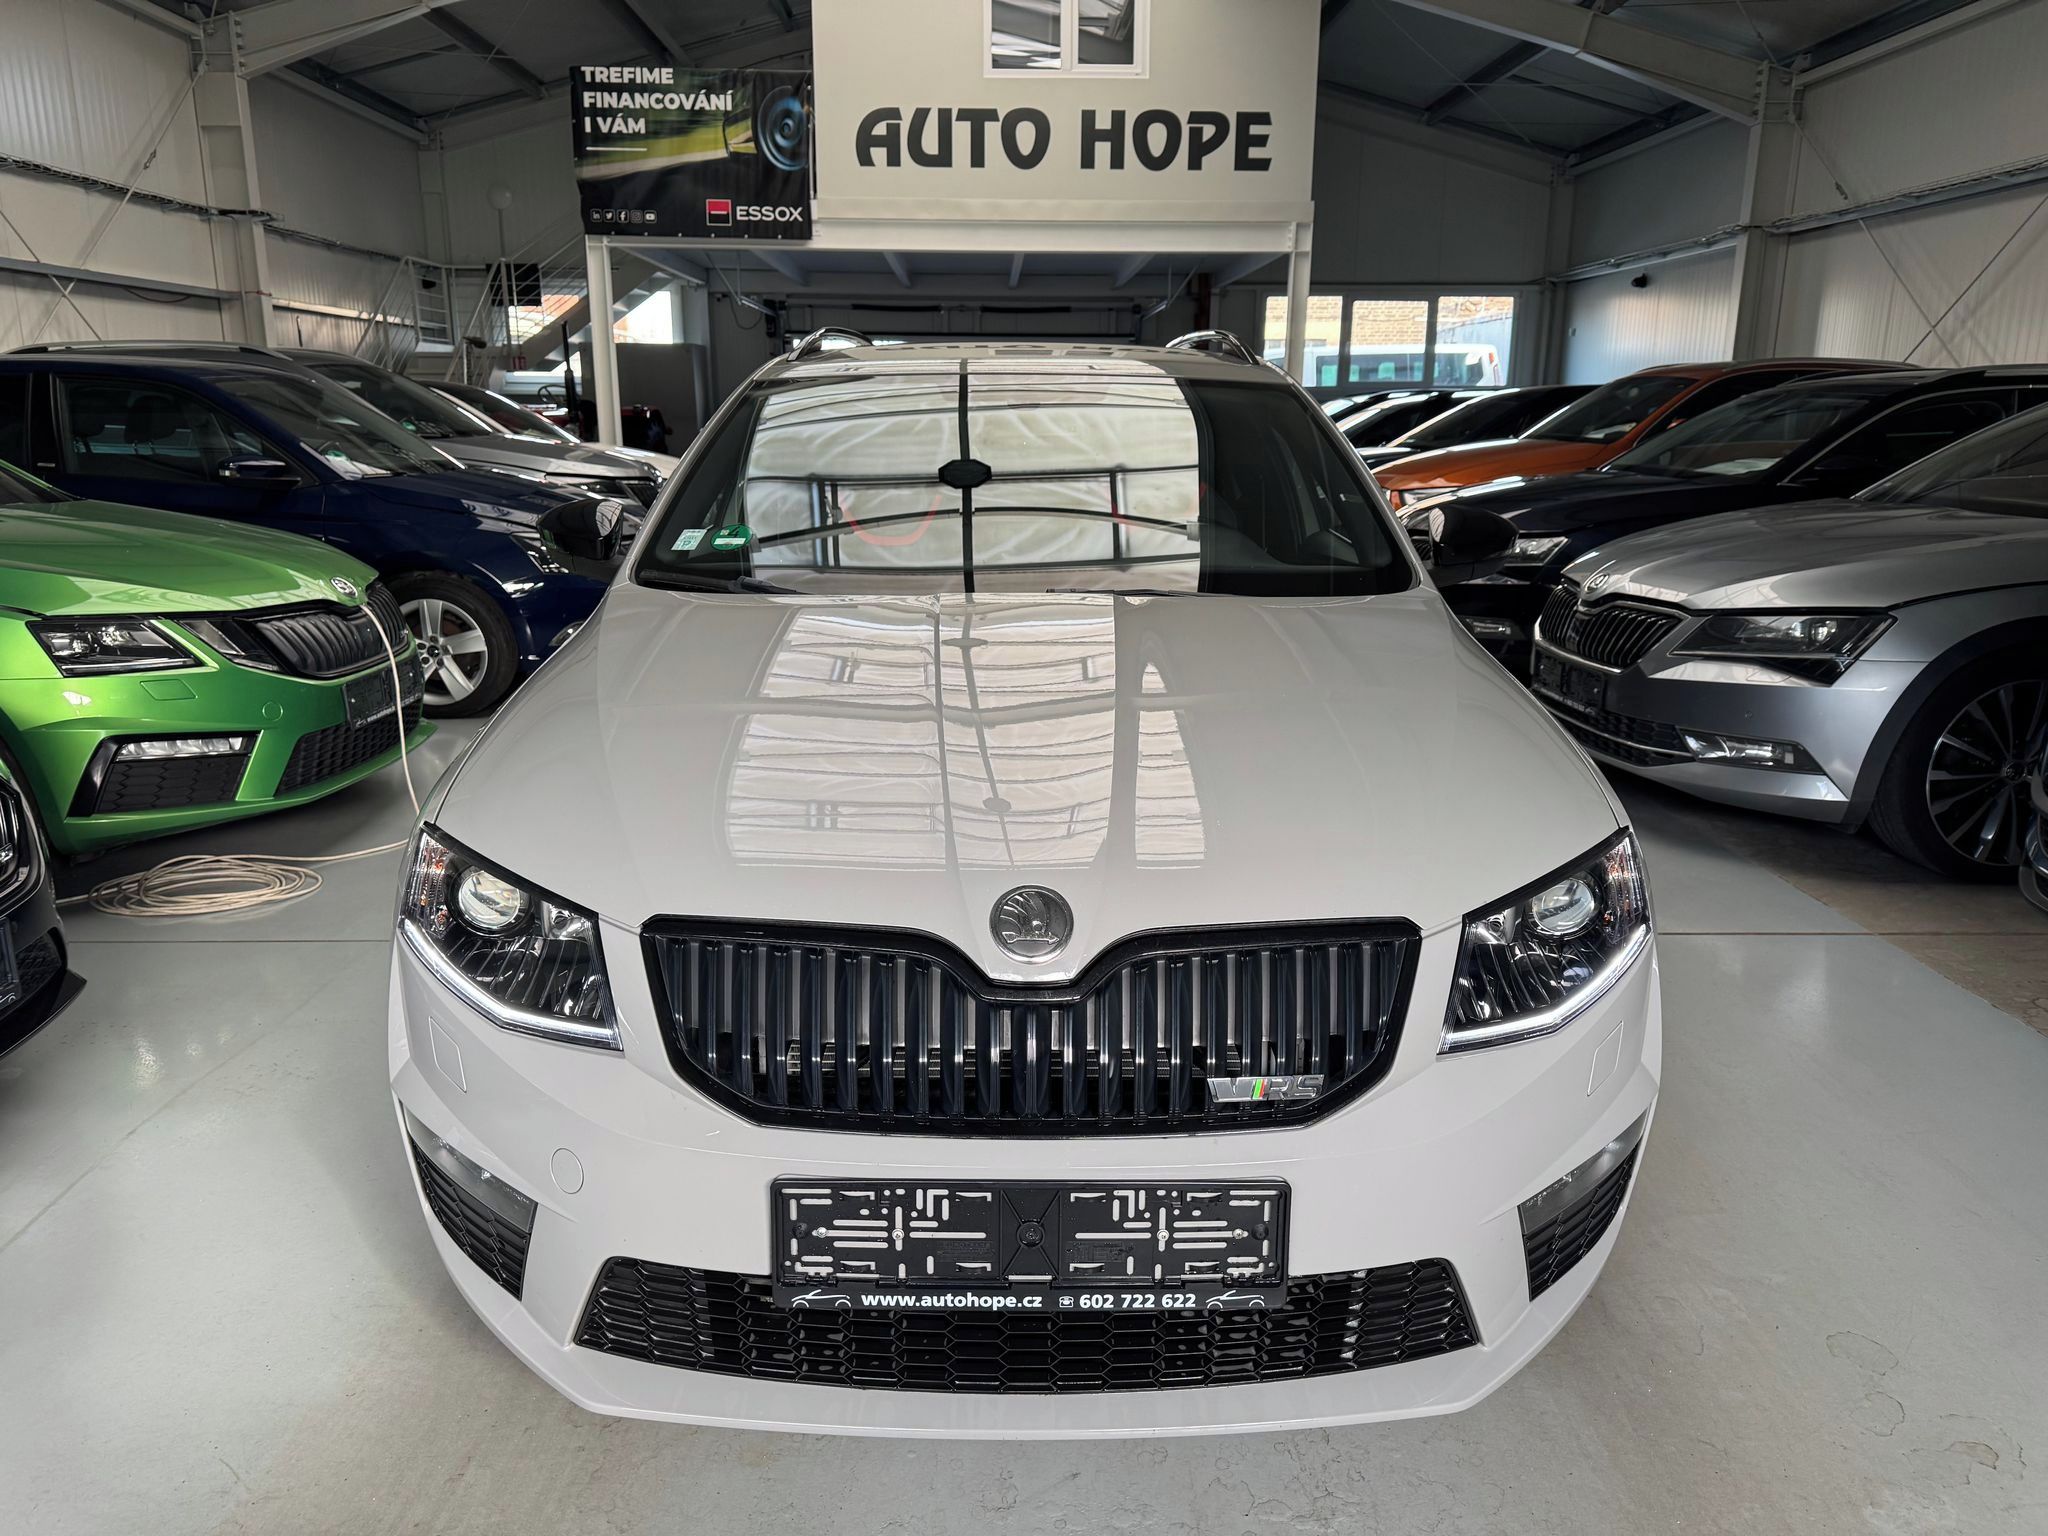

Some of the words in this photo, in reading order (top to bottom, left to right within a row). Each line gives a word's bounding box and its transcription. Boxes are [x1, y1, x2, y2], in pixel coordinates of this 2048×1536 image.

[581, 66, 673, 84] TREFIME
[582, 90, 733, 111] FINANCOVÁNÍ
[584, 117, 591, 133] I
[597, 113, 646, 134] VÁM
[856, 106, 1051, 170] AUTO
[1080, 108, 1273, 171] HOPE
[735, 206, 804, 223] ESSOX
[726, 526, 740, 538] 4
[861, 1292, 1042, 1311] www.autohope.cz
[1079, 1293, 1114, 1309] 602
[1120, 1293, 1155, 1309] 722
[1161, 1293, 1196, 1309] 622
